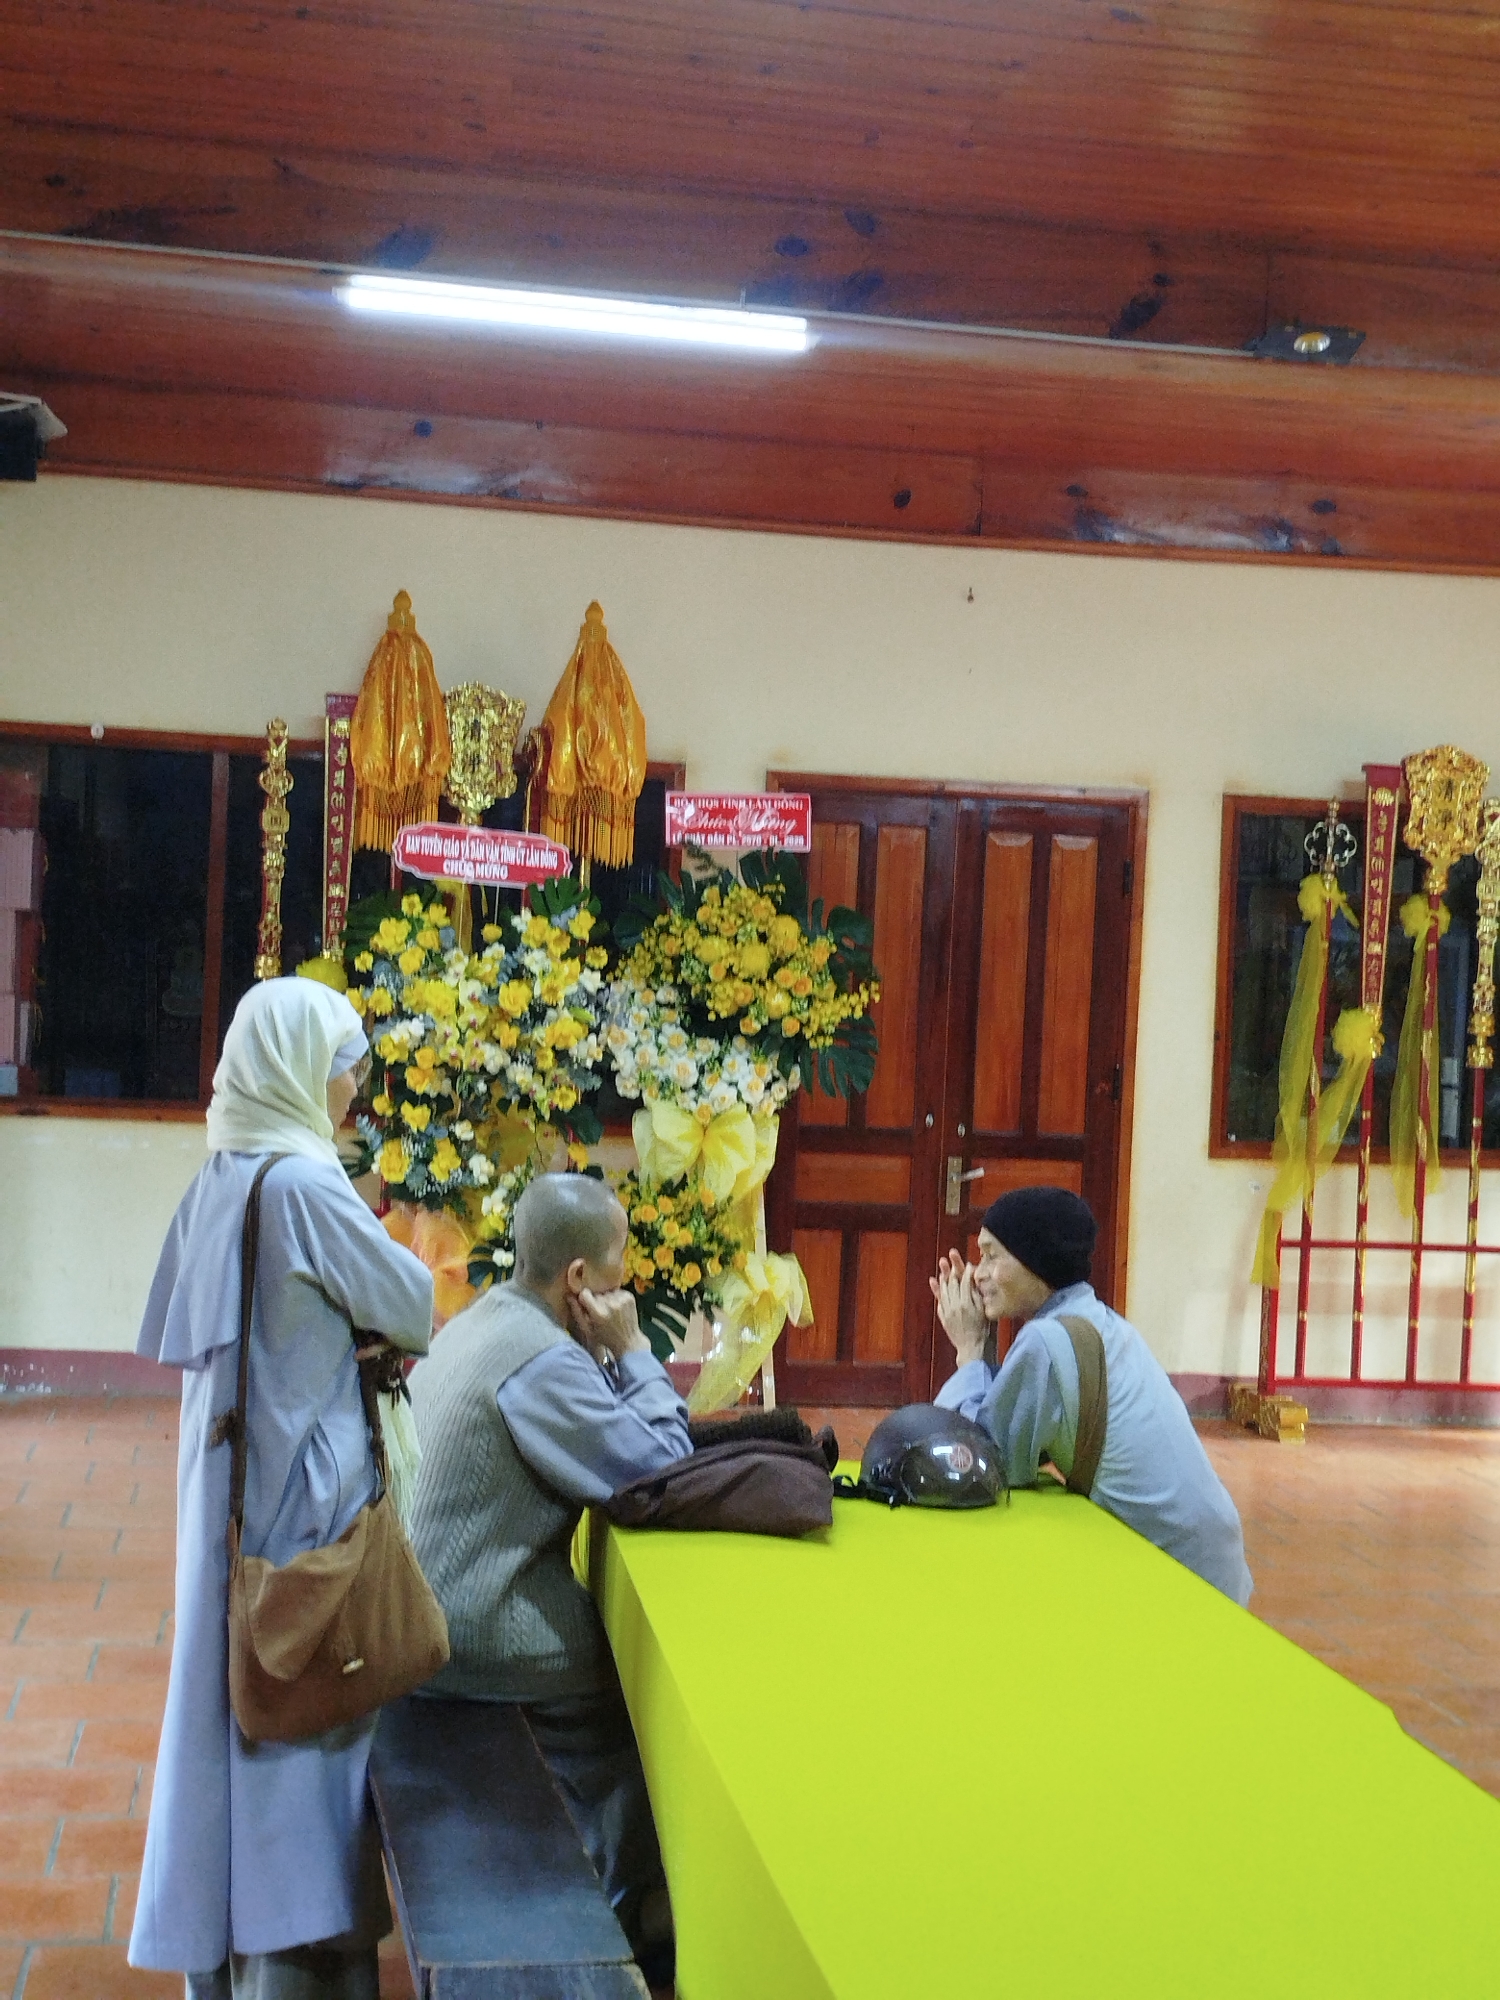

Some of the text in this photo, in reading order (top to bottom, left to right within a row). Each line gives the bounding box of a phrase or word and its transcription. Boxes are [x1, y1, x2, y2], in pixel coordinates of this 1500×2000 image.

[405, 834, 420, 854] BAN
[443, 834, 460, 858] GIÁO
[526, 843, 539, 868] LÂM
